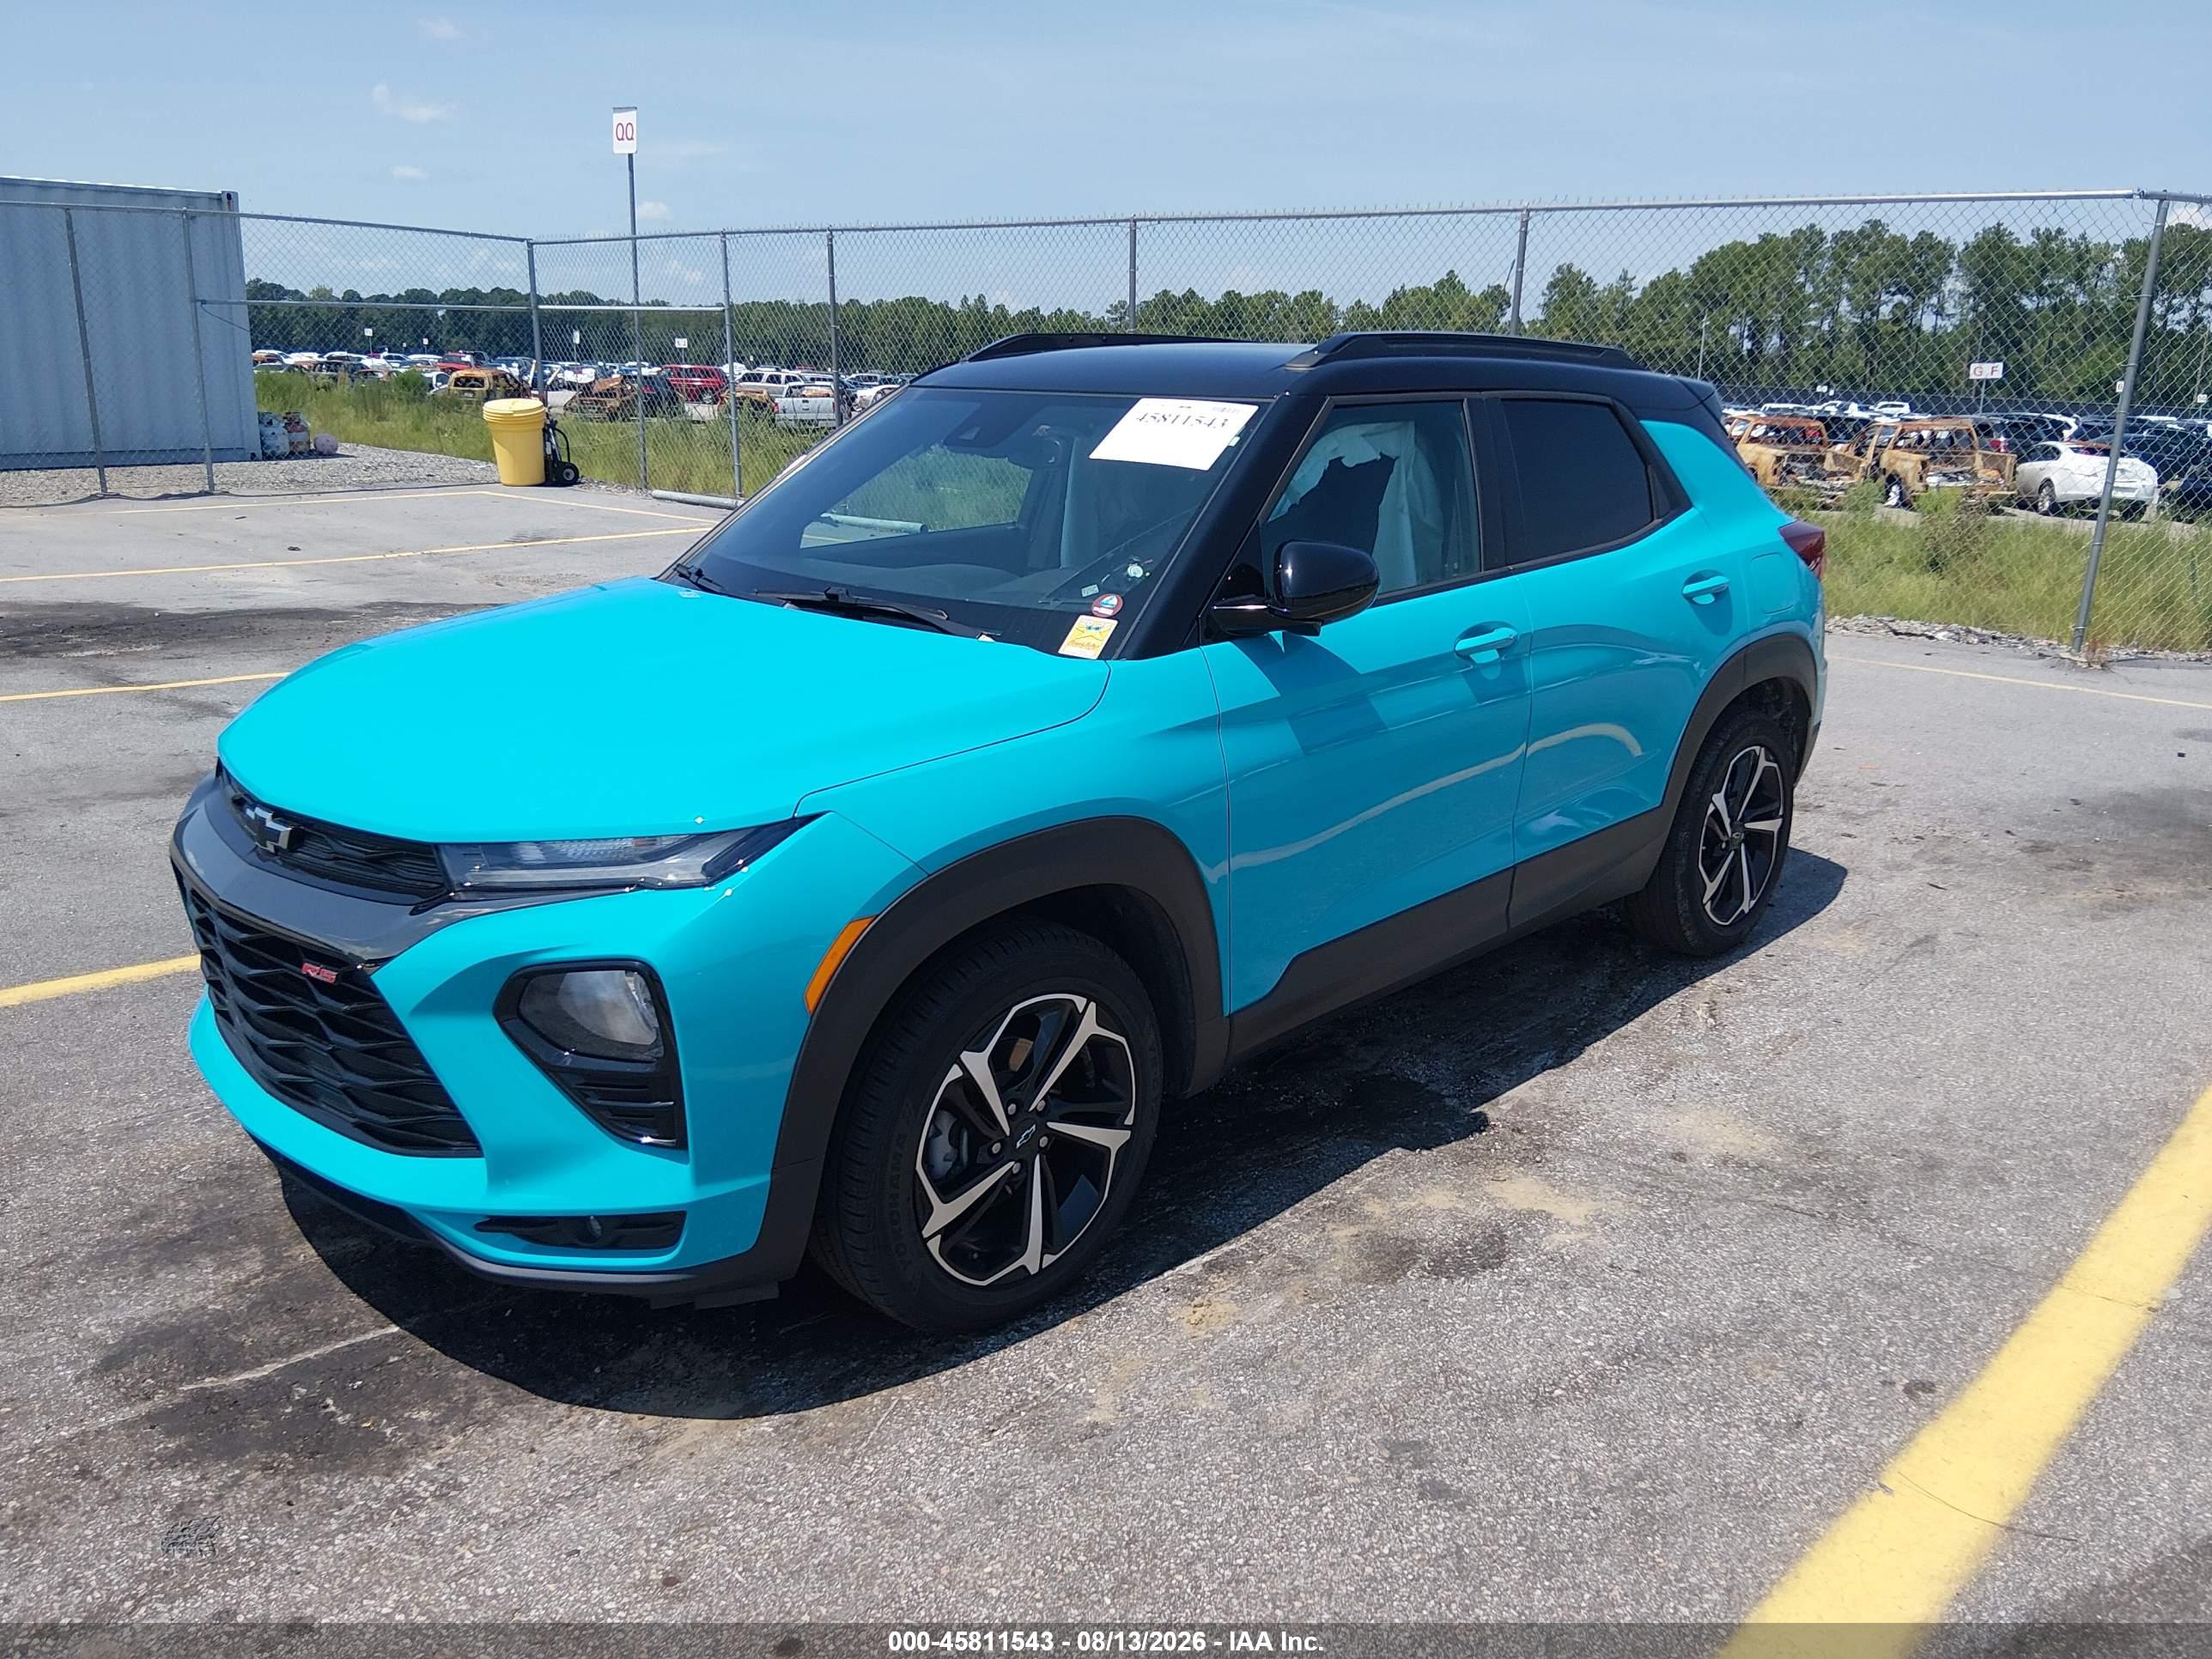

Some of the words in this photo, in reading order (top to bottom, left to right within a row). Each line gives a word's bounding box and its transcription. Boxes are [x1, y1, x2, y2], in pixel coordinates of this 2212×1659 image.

[616, 122, 635, 142] QQ
[1973, 366, 1984, 377] G
[1990, 366, 1999, 376] F
[301, 962, 338, 983] RS
